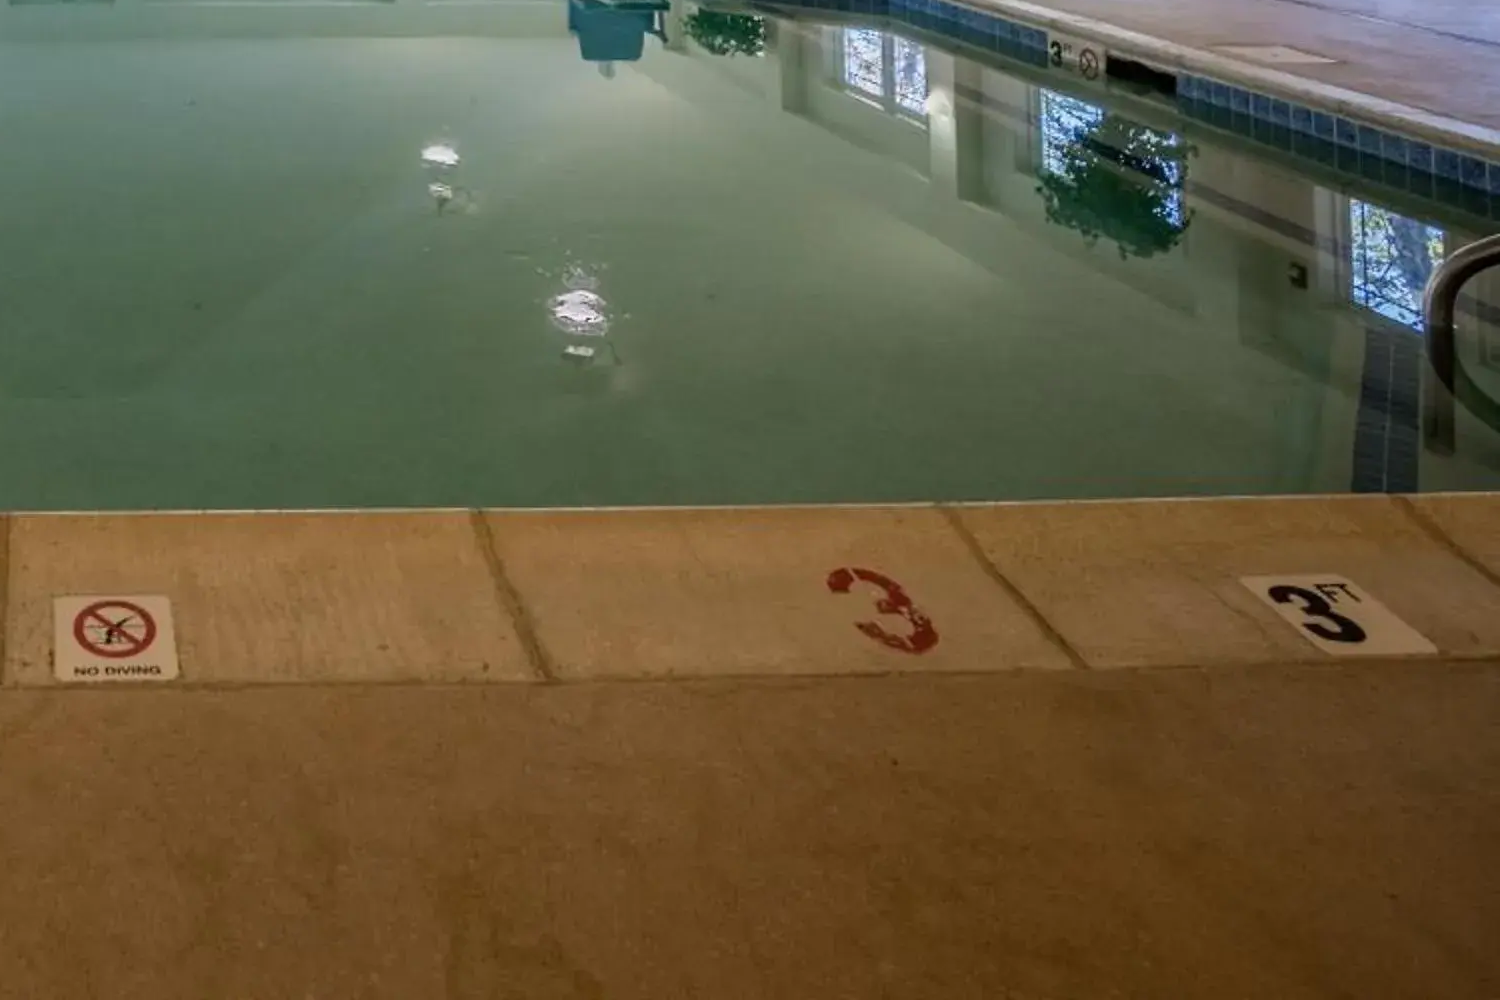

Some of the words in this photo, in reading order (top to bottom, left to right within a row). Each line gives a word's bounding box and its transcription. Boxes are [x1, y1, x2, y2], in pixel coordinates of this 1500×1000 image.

[1050, 40, 1062, 67] 3
[1314, 583, 1361, 603] FT
[827, 568, 939, 655] 3
[1268, 585, 1367, 643] 3
[73, 666, 99, 676] NO
[105, 666, 162, 676] DIVING
